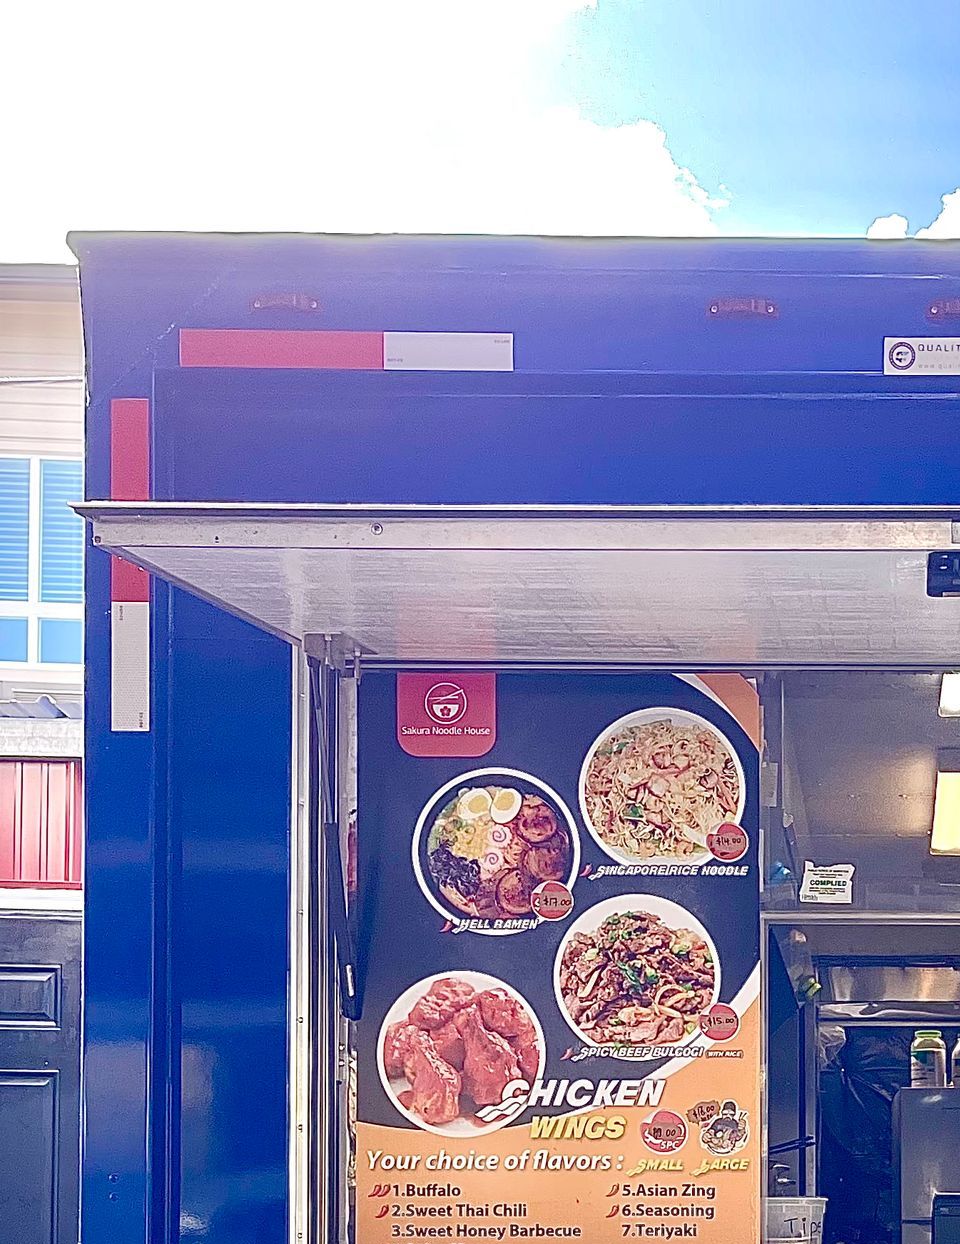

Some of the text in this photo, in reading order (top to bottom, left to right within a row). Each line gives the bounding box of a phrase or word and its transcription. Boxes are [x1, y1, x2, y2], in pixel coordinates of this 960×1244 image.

[402, 725, 490, 736] Sakura Noodle House
[669, 866, 698, 876] RICE
[702, 866, 748, 876] NOODLE
[458, 919, 538, 931] HELL RAMEN
[580, 1047, 704, 1059] SPICY BEEF BULGOGI
[500, 1079, 666, 1107] CHICKEN
[530, 1115, 627, 1139] WINGS
[367, 1150, 612, 1170] Your choice of flavors
[636, 1159, 684, 1171] SMALL
[699, 1158, 749, 1171] LARGE
[392, 1184, 461, 1197] 1.Buffalo
[622, 1184, 715, 1199] 5.Asian Zing
[392, 1205, 527, 1217] 2.Sweet Thai Chili
[622, 1204, 715, 1219] 6.Seasoning
[392, 1225, 581, 1240] 3.Sweet Honey Barbecue
[622, 1225, 697, 1239] 7.Teriyaki
